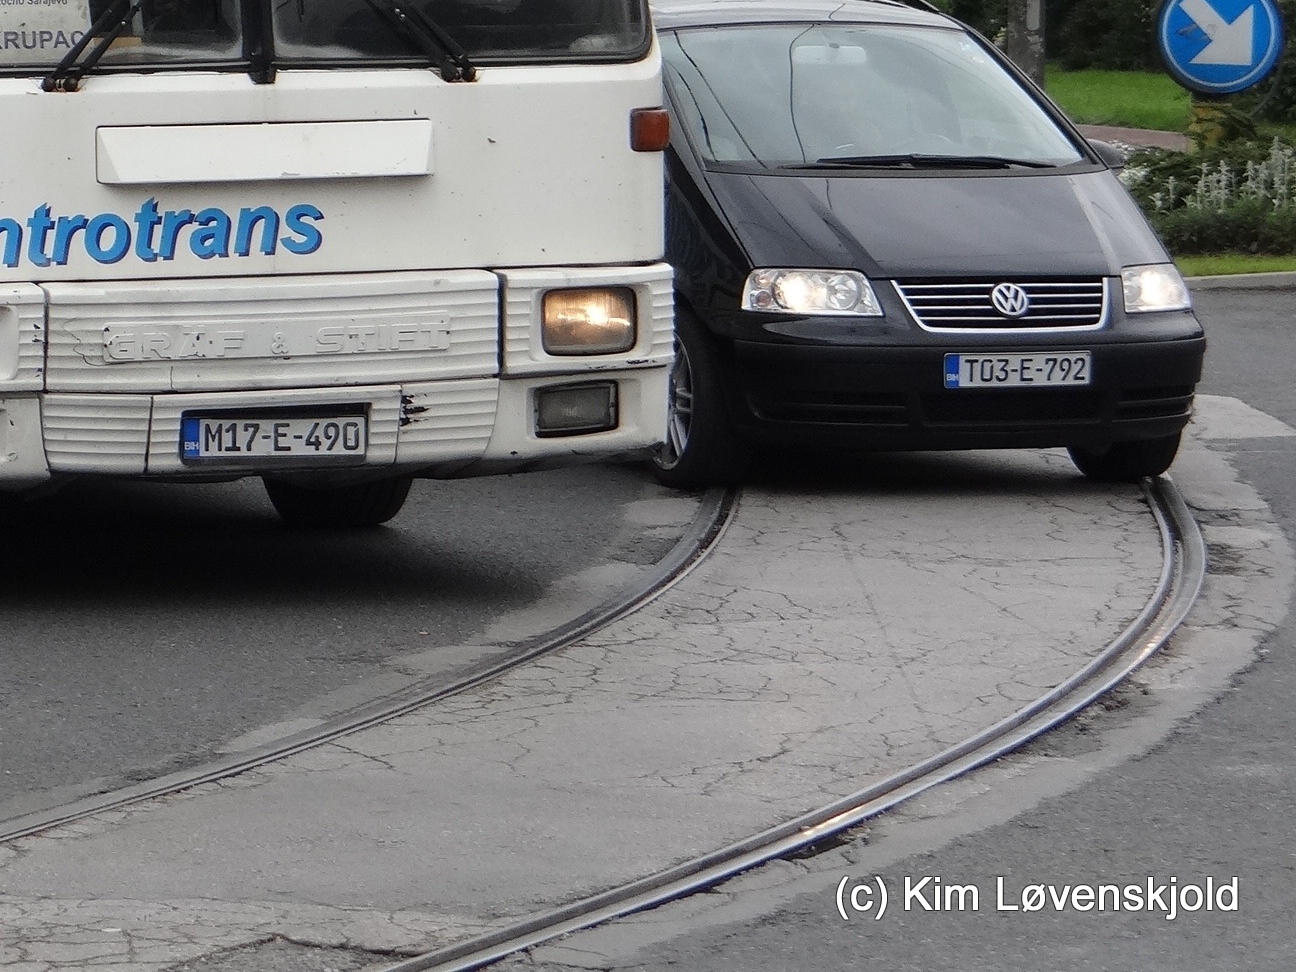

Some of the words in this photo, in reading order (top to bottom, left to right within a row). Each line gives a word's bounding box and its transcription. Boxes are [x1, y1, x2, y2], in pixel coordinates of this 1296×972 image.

[270, 331, 290, 355] &
[315, 322, 449, 354] STIFT
[965, 358, 1087, 383] T03-E-792
[204, 421, 360, 452] M17-E-490
